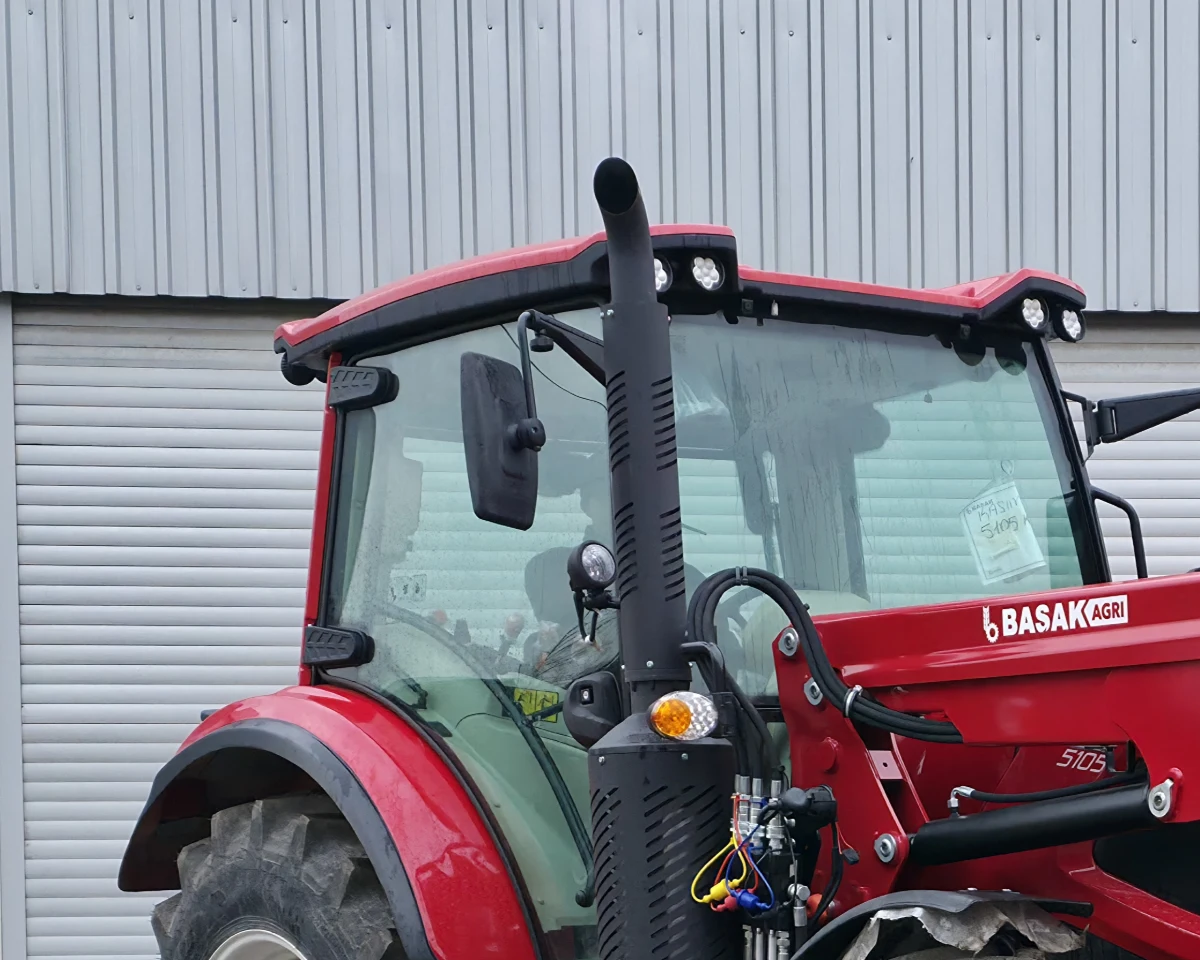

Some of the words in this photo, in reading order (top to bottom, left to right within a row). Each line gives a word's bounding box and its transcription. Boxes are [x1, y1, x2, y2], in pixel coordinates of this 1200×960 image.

[980, 515, 1019, 539] 5105
[1002, 600, 1088, 637] BASAK
[1092, 601, 1124, 620] AGRI
[1056, 748, 1106, 773] 5105
